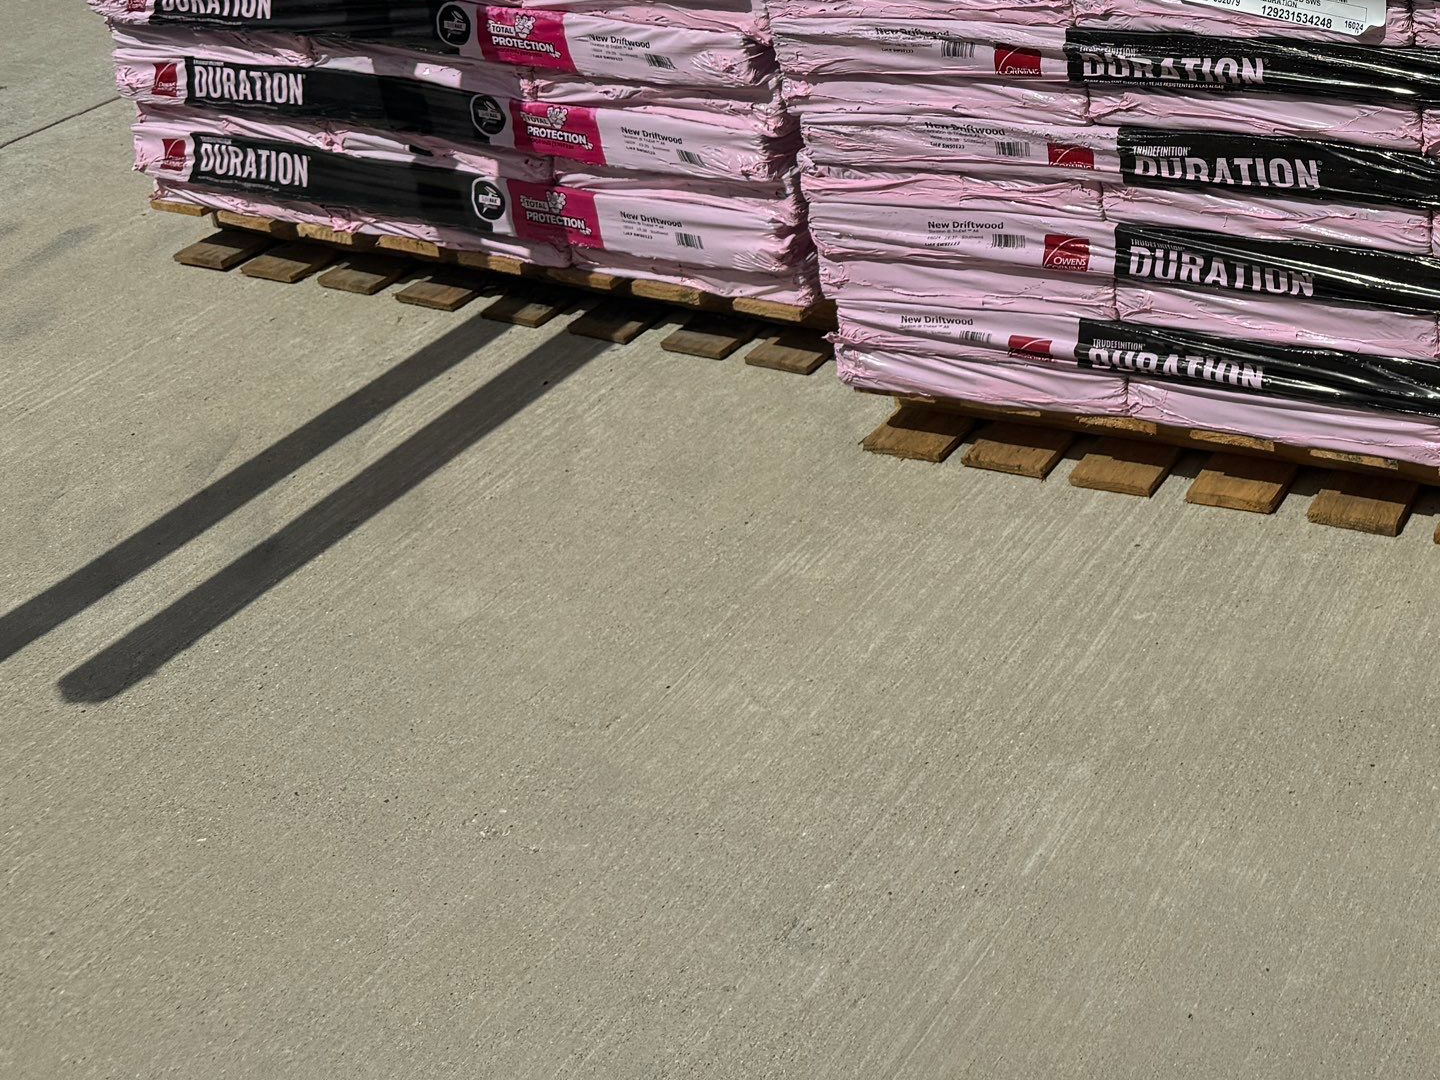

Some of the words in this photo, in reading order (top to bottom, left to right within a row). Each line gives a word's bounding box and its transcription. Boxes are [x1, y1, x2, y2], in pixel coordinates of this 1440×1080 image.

[1261, 5, 1332, 28] 129231534248
[193, 65, 303, 106] DURATION
[527, 127, 587, 145] PROTECTION
[621, 126, 640, 135] New
[642, 129, 683, 144] Driftwood
[200, 142, 308, 188] DURATION
[1134, 155, 1321, 189] DURATION
[928, 220, 950, 230] New
[953, 220, 1004, 230] Driftwood
[1053, 256, 1087, 266] OWENS
[1129, 246, 1314, 297] DURATION
[1093, 339, 1146, 351] TRUDEFINITION
